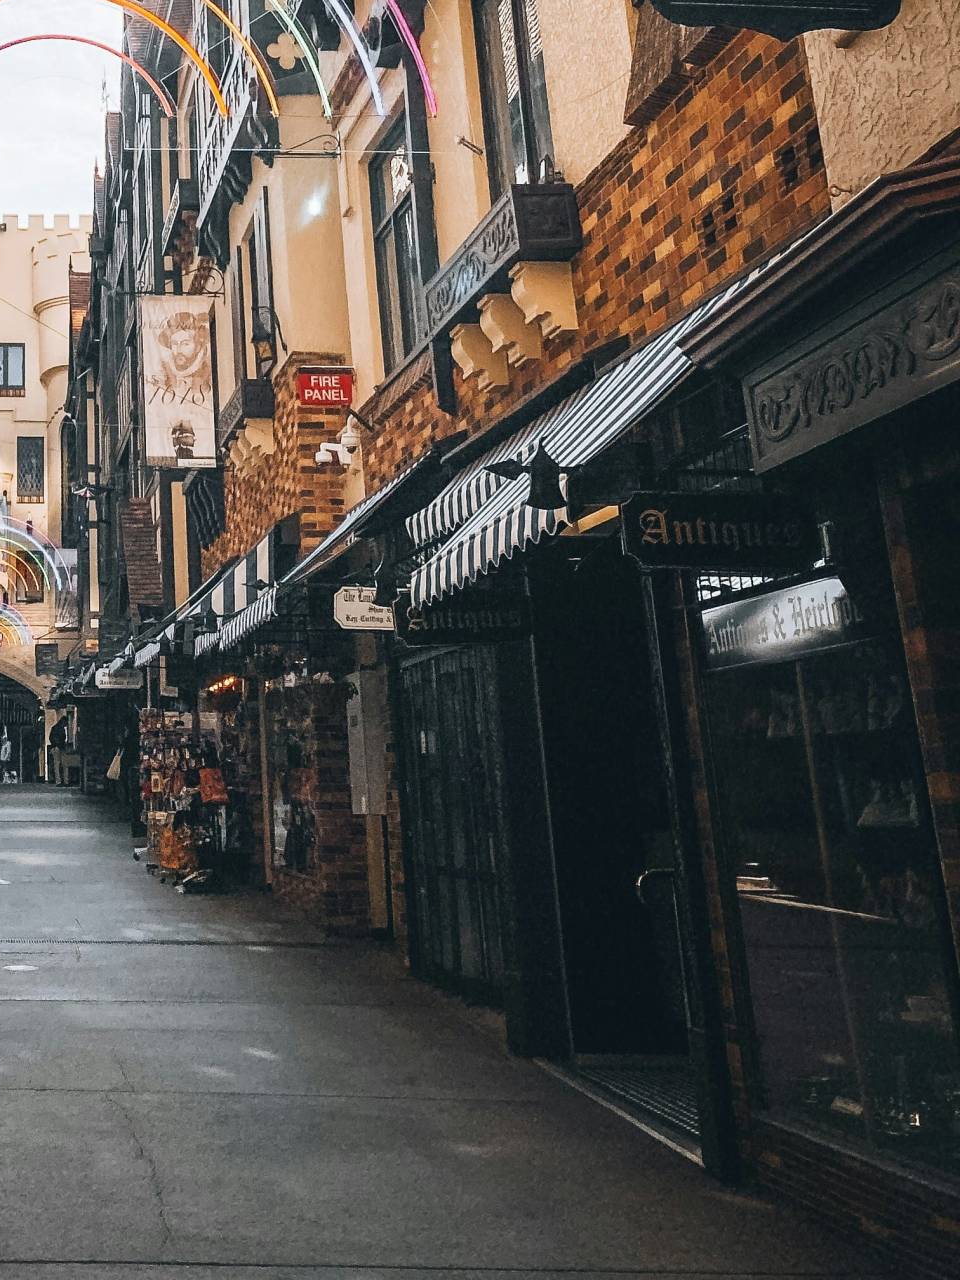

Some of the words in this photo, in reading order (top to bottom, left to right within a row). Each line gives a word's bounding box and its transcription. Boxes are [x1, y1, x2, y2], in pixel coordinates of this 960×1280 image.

[310, 375, 341, 387] FIRE
[304, 389, 349, 401] PANEL
[639, 508, 802, 551] Antiques
[343, 589, 356, 602] The
[772, 603, 786, 640] &
